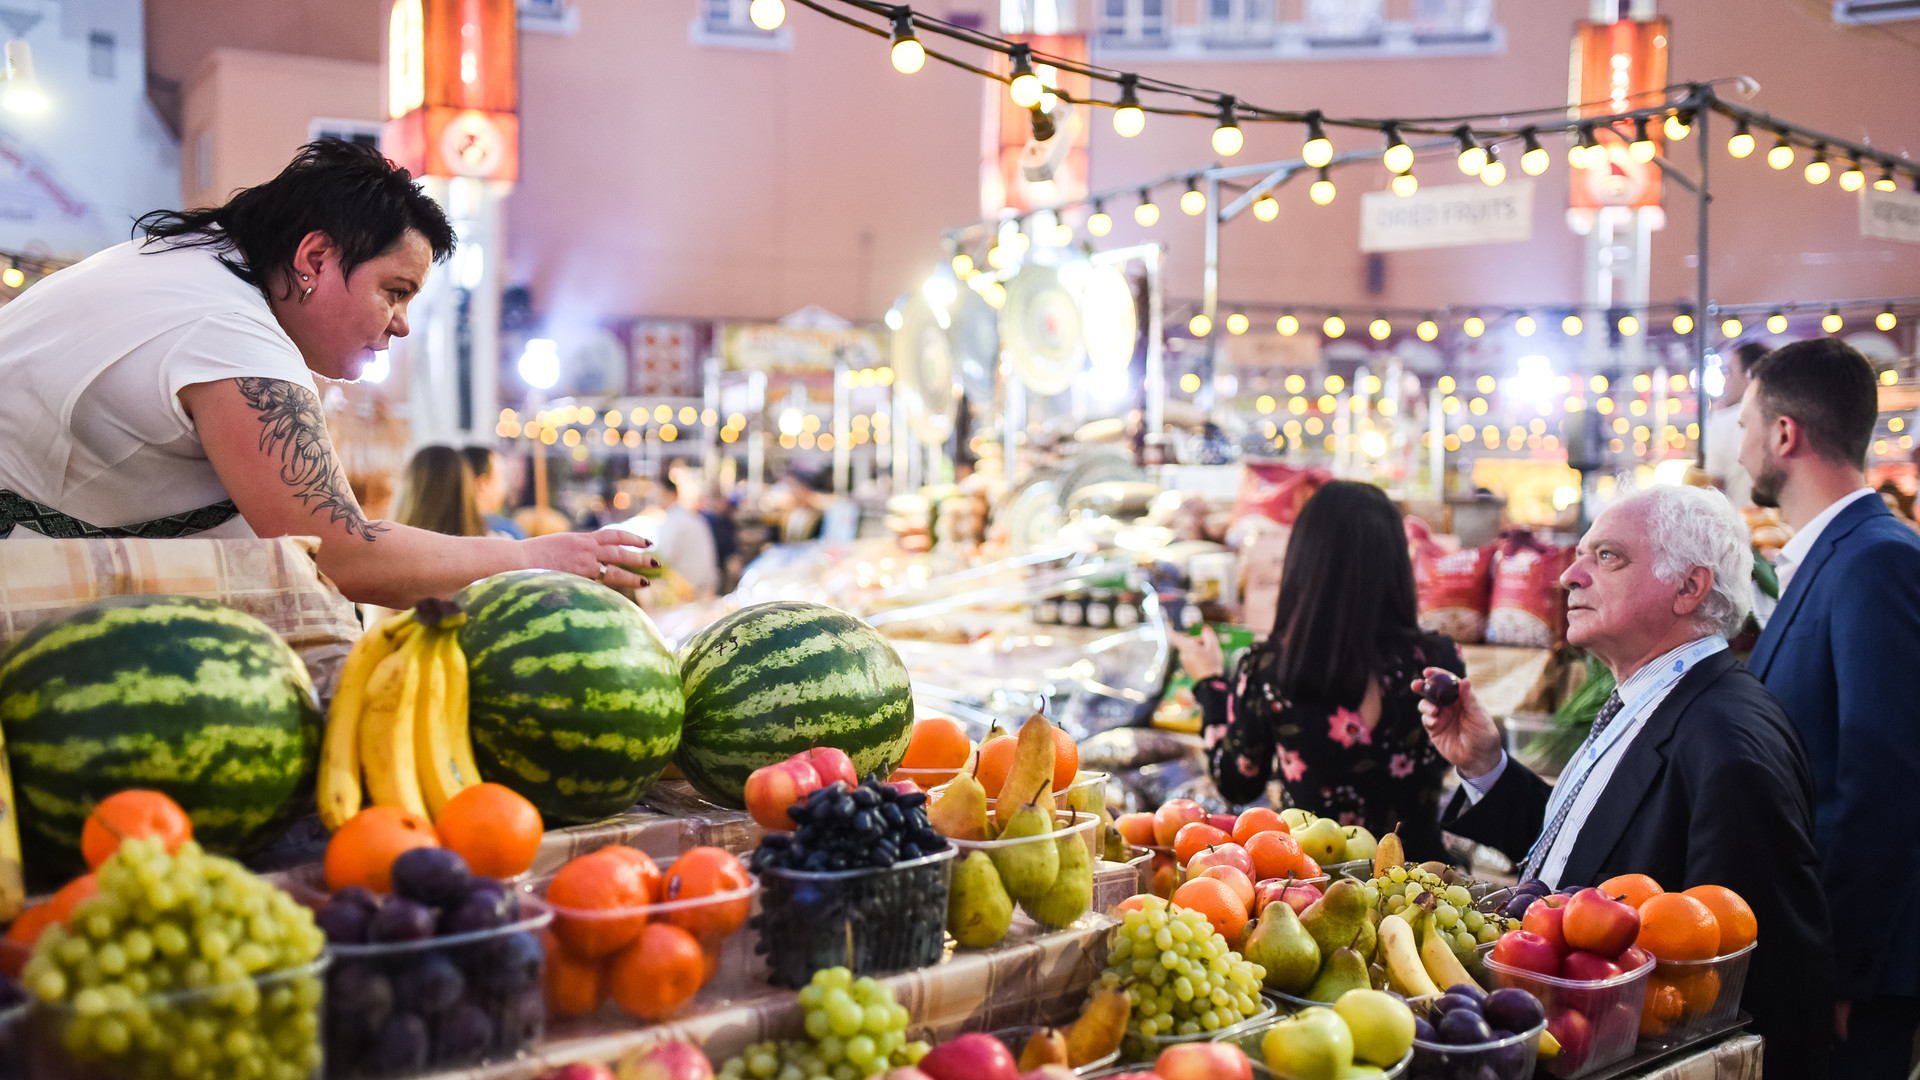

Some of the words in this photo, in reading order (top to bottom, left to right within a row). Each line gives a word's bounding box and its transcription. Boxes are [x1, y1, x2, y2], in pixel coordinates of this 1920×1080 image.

[1376, 204, 1438, 229] DRIED
[1442, 196, 1518, 224] FRUITS
[1639, 677, 1665, 701] strategy
